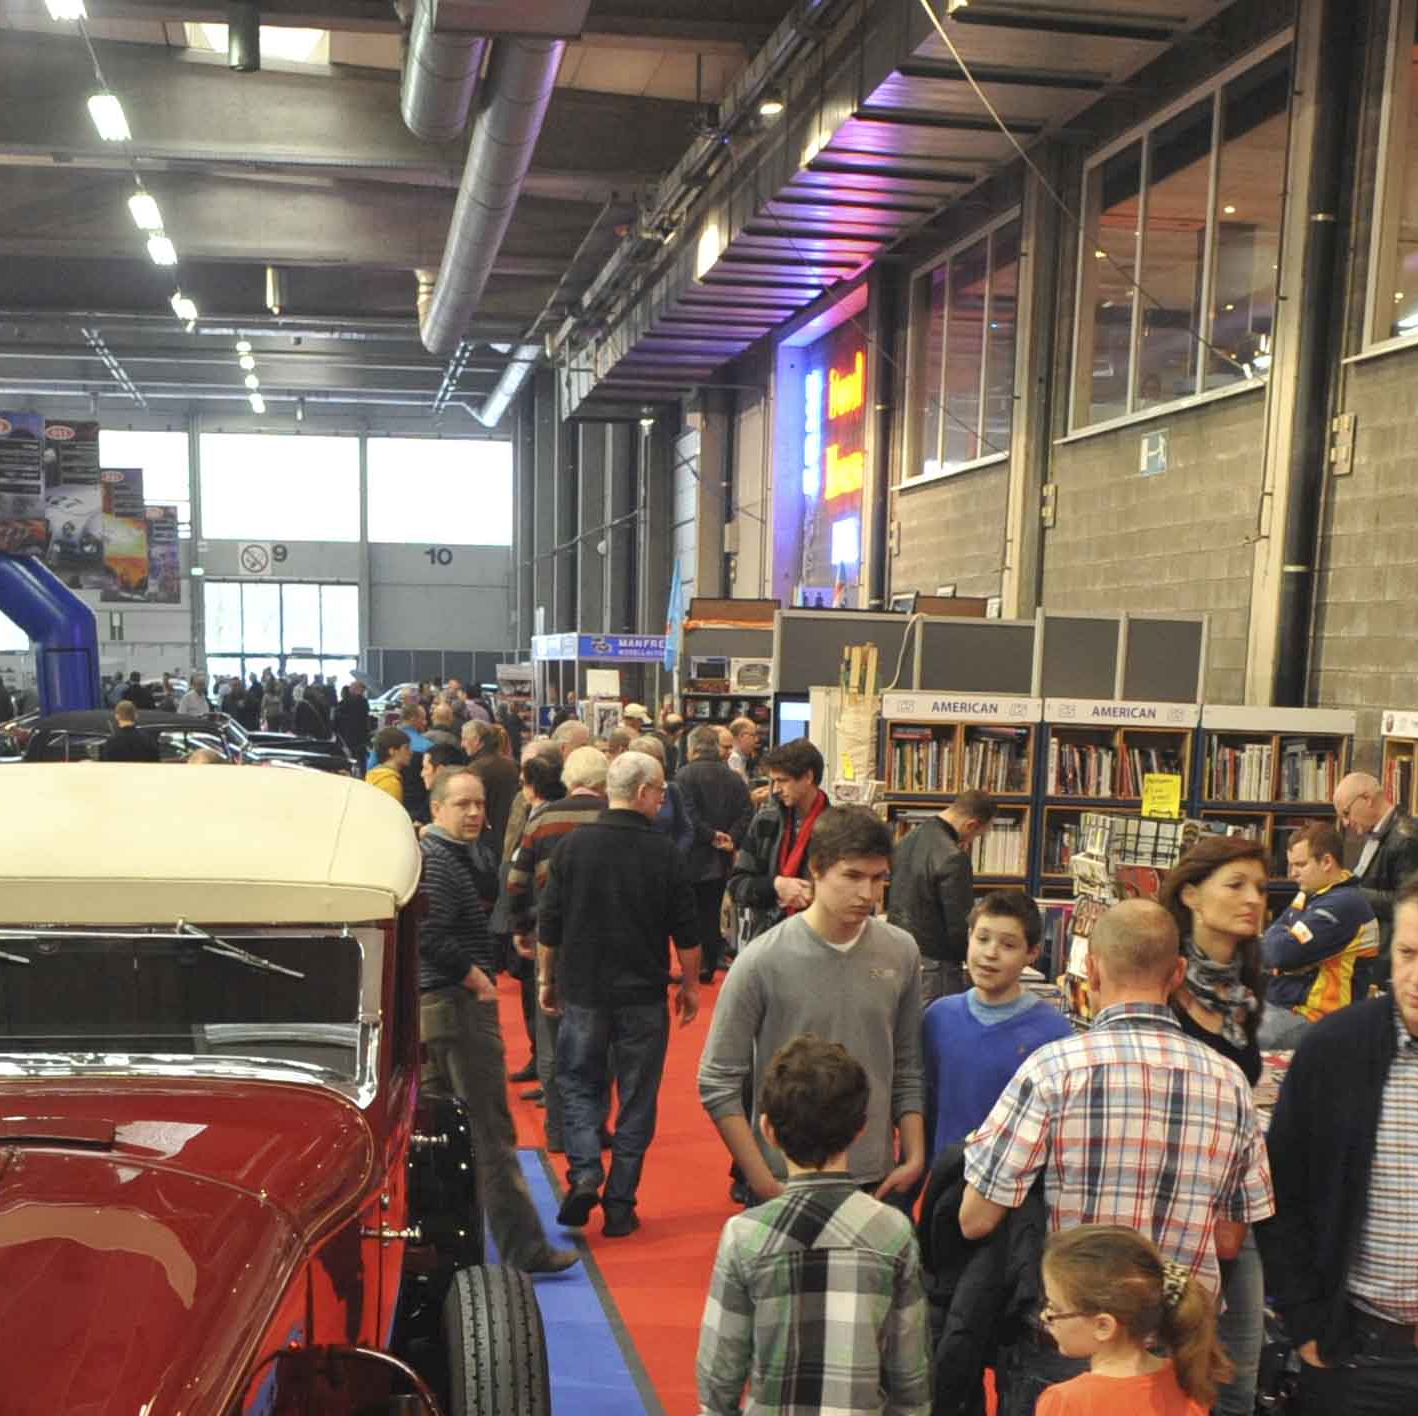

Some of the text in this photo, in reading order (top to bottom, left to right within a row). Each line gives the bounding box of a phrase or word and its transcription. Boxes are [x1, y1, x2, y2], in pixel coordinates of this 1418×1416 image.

[271, 544, 288, 563] 9
[424, 547, 453, 566] 10
[618, 638, 665, 648] MANFRE
[931, 700, 998, 715] AMERICAN
[1091, 706, 1157, 720] AMERICAN
